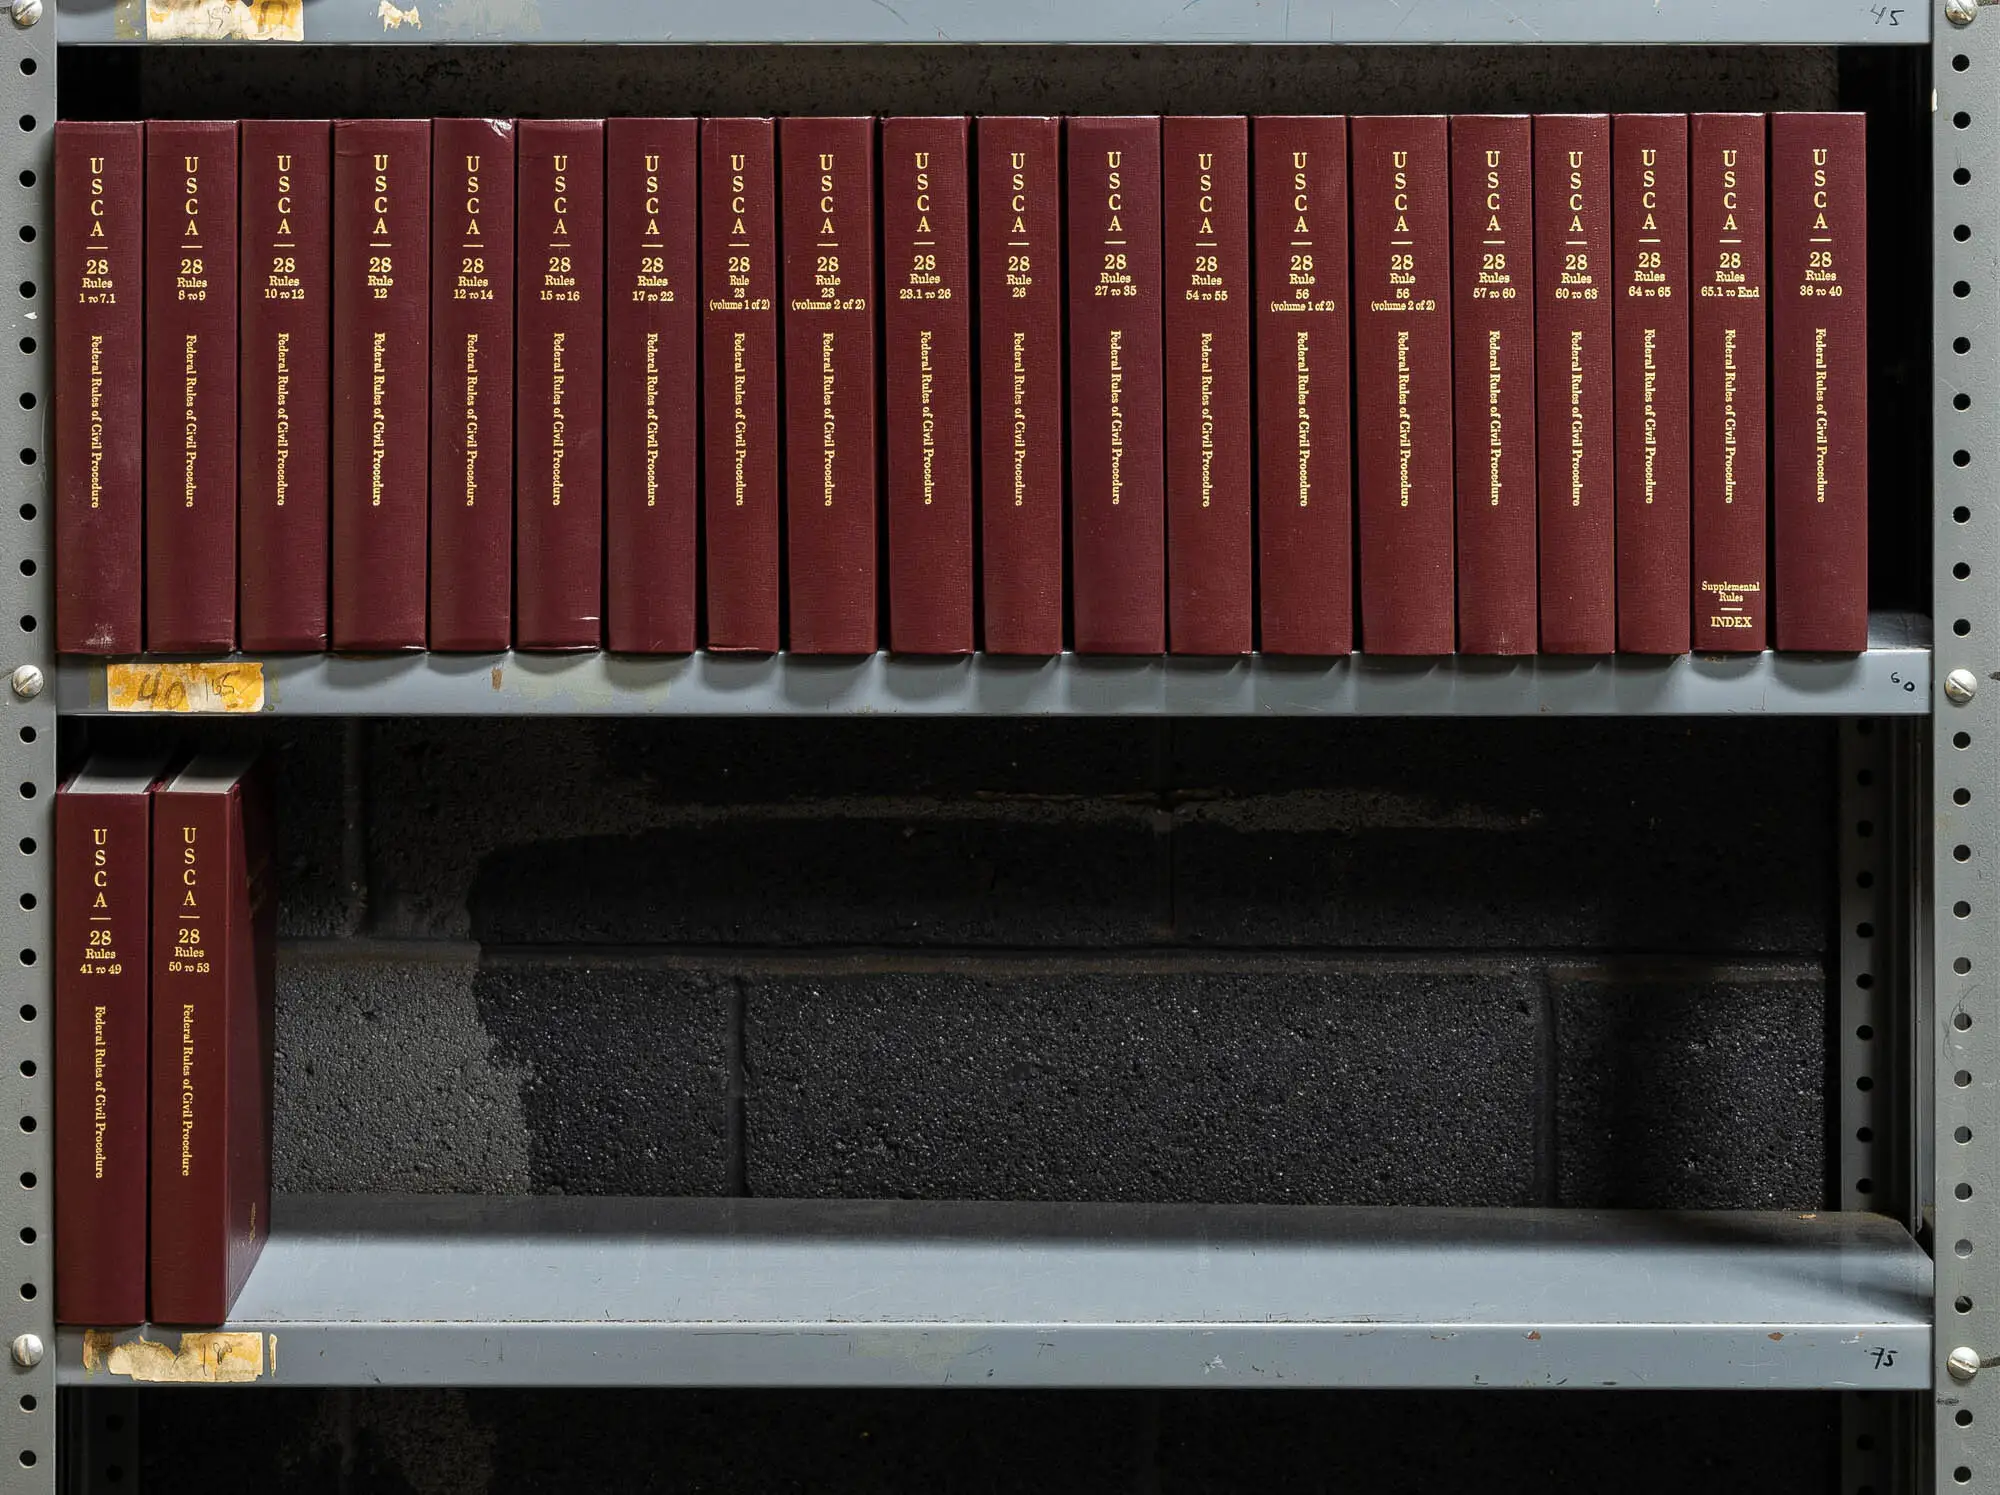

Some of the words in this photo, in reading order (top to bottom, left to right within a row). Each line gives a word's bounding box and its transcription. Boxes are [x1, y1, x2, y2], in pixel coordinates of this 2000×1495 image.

[1870, 4, 1904, 26] 45
[86, 258, 109, 275] 28
[180, 258, 204, 275] 28
[273, 257, 296, 274] 28
[368, 256, 393, 274] 28
[462, 257, 485, 274] 28
[548, 256, 572, 273] 28
[641, 256, 665, 274] 28
[727, 256, 751, 273] 28
[816, 255, 840, 273] 28
[913, 254, 937, 271] 28
[1007, 255, 1031, 272] 28
[1104, 253, 1127, 271] 28
[1195, 255, 1218, 273] 28
[1290, 254, 1314, 272] 28
[1390, 253, 1415, 271] 28
[1482, 253, 1506, 271] 28
[1564, 253, 1589, 271] 28
[1638, 251, 1662, 269] 28
[1719, 251, 1742, 270] 28
[1809, 251, 1833, 268] 28
[268, 275, 301, 287] Rules
[367, 274, 394, 287] Rule
[457, 275, 489, 288] Rules
[544, 274, 576, 287] Rules
[636, 275, 669, 287] Rules
[729, 274, 750, 287] Rule
[814, 274, 842, 286] Rule
[909, 272, 942, 285] Rules
[1005, 273, 1033, 286] Rule
[1099, 271, 1132, 284] Rules
[1191, 273, 1223, 286] Rules
[1288, 272, 1316, 285] Rule
[1389, 271, 1417, 285] Rule
[1478, 271, 1511, 284] Rules
[1560, 272, 1593, 285] Rules
[1633, 269, 1666, 283] Rules
[1715, 270, 1746, 283] Rules
[1804, 268, 1837, 282] Rules
[81, 277, 114, 289] Rules
[176, 276, 208, 289] Rules
[264, 287, 278, 299] 10
[291, 288, 305, 300] 12
[373, 287, 388, 299] 12
[632, 290, 646, 302] 17
[659, 290, 675, 302] 22
[936, 288, 952, 300] 26
[1011, 286, 1027, 299] 26
[1094, 284, 1109, 297] 27
[1295, 288, 1310, 300] 56
[1395, 287, 1411, 300] 56
[1554, 287, 1570, 300] 60
[1700, 285, 1724, 298] 65.1
[1737, 285, 1761, 299] End
[1827, 285, 1843, 297] 40
[79, 292, 86, 304] 1
[99, 292, 117, 304] 7.1
[709, 298, 743, 311] (volume
[743, 299, 750, 310] 1
[750, 298, 762, 311] of
[761, 298, 771, 311] 2)
[791, 298, 833, 311] (volume
[833, 298, 841, 310] 2
[842, 298, 855, 311] of
[854, 298, 866, 311] 2)
[1370, 299, 1407, 312] (volume
[1407, 299, 1415, 311] 2
[1414, 299, 1426, 311] of
[1425, 299, 1436, 312] 2)
[646, 332, 659, 374] Federal
[1110, 329, 1123, 371] Federal
[1815, 327, 1828, 369] Federal
[91, 335, 103, 376] Federal
[91, 377, 103, 408] Rules
[646, 375, 659, 407] Rules
[1110, 372, 1123, 404] Rules
[1815, 370, 1828, 402] Rules
[91, 409, 103, 423] of
[647, 407, 659, 421] of
[1111, 405, 1123, 419] of
[1815, 403, 1828, 417] of
[91, 423, 103, 450] Civil
[647, 421, 659, 449] Civil
[1111, 419, 1123, 446] Civil
[1815, 417, 1828, 444] Civil
[91, 451, 103, 509] Procedure
[647, 449, 659, 507] Procedure
[1111, 447, 1124, 505] Procedure
[1816, 445, 1829, 503] Procedure
[1701, 580, 1761, 594] Supplemental
[1718, 591, 1744, 603] Rules
[1710, 615, 1753, 629] INDEX
[1890, 671, 1916, 692] 60
[89, 929, 112, 946] 28
[178, 928, 201, 945] 28
[84, 947, 117, 960] Rules
[174, 946, 205, 958] Rules
[79, 963, 94, 974] 41
[107, 963, 122, 975] 49
[168, 961, 183, 972] 50
[183, 1003, 194, 1044] Federal
[182, 1046, 194, 1077] Rules
[182, 1078, 194, 1091] of
[182, 1091, 194, 1119] Civil
[181, 1119, 193, 1177] Procedure
[1869, 1346, 1899, 1370] 75
